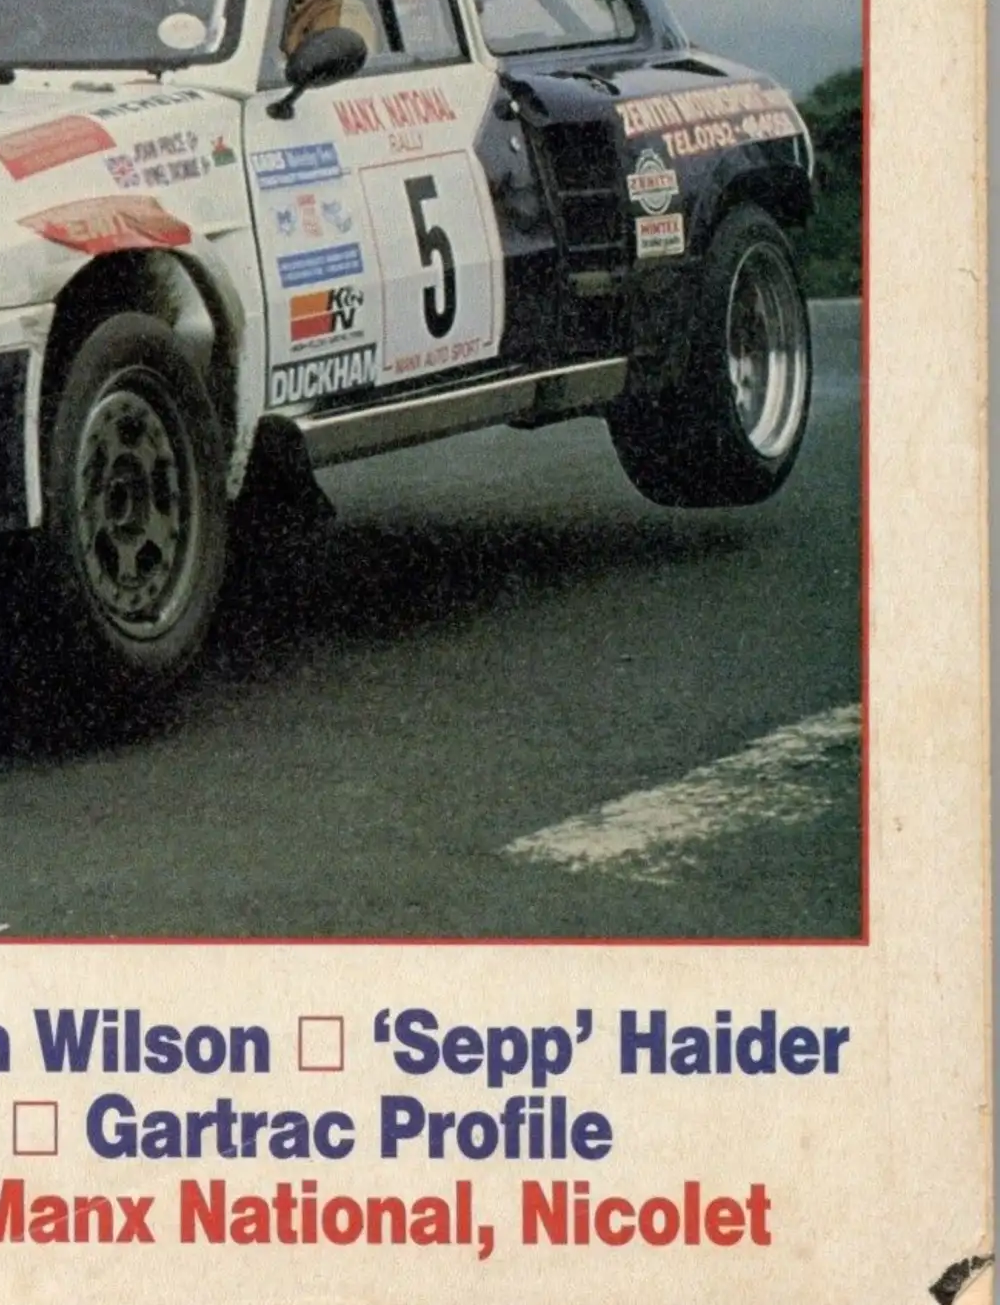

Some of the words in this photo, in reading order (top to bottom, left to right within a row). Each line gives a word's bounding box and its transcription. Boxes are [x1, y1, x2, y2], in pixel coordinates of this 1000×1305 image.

[404, 174, 458, 339] 5
[34, 1009, 270, 1074] Wilson
[621, 1010, 850, 1075] Haider
[86, 1093, 355, 1159] Gartrac
[381, 1094, 613, 1160] Profile
[180, 1180, 495, 1258] National,
[521, 1181, 772, 1246] Nicolet
